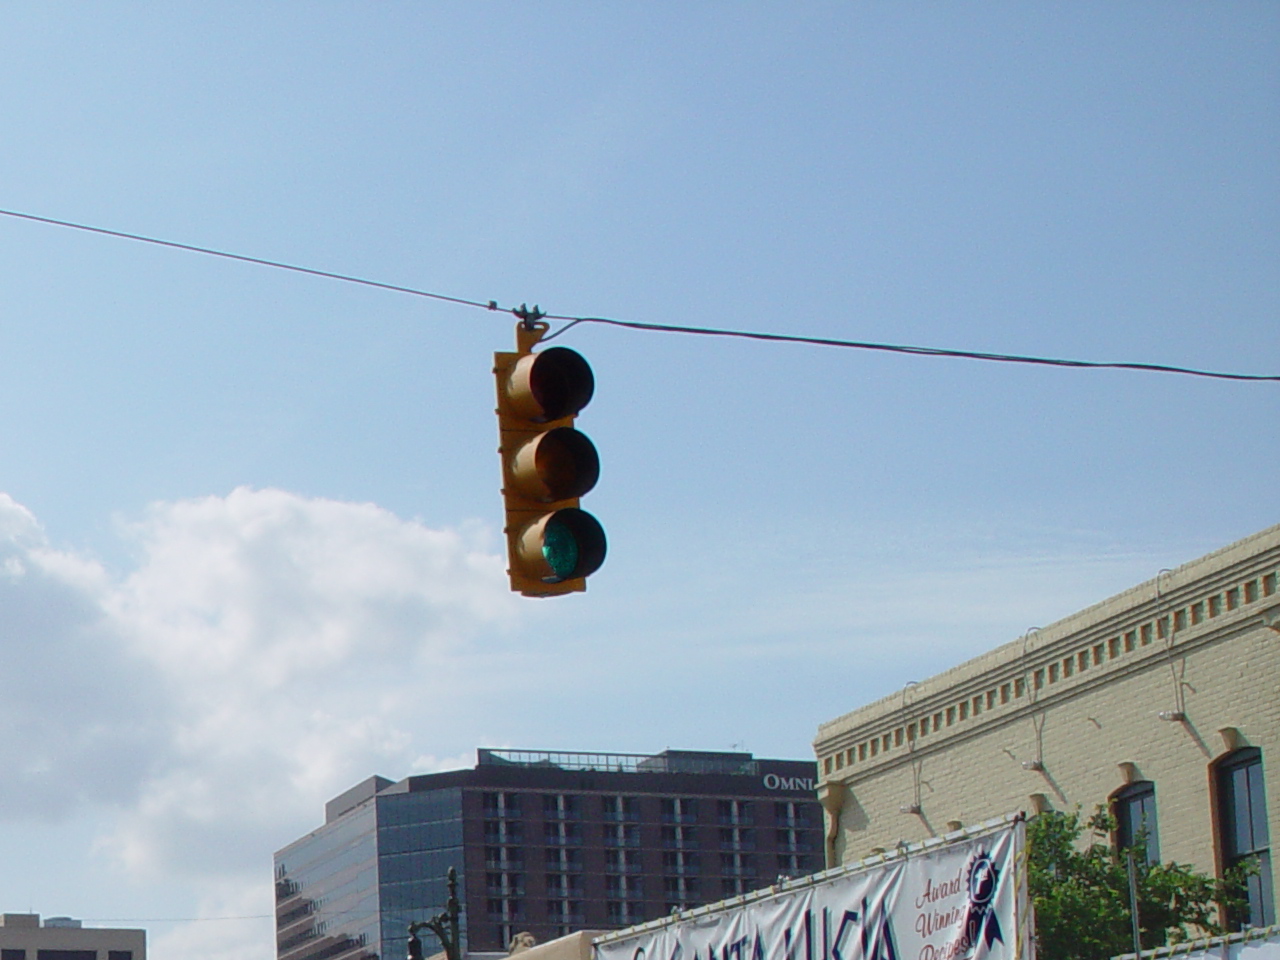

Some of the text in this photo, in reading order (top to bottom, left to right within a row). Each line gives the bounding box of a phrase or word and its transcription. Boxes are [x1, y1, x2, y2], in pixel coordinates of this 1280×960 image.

[763, 773, 813, 791] OMNI
[915, 869, 962, 908] Award
[915, 905, 966, 938] Winning
